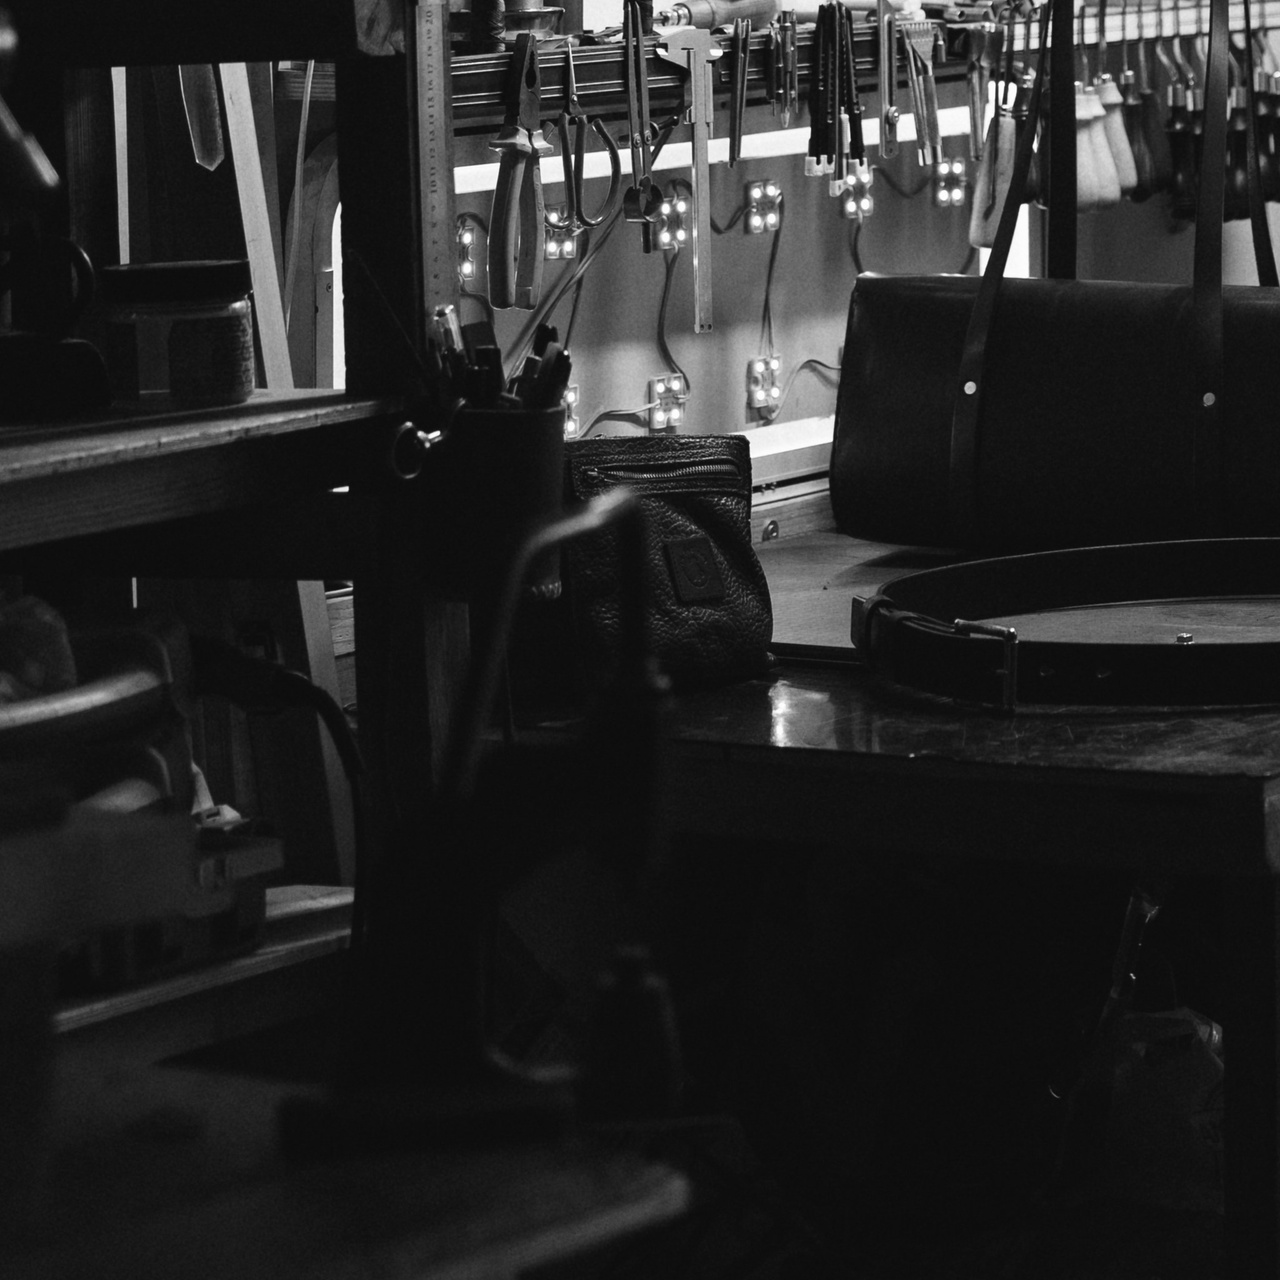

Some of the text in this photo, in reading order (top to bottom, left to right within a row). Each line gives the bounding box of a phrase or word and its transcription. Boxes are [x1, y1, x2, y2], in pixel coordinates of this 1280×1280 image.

[425, 9, 433, 25] 20
[427, 62, 433, 74] 17
[427, 96, 435, 108] 15
[430, 166, 437, 176] 11
[430, 179, 438, 193] 10
